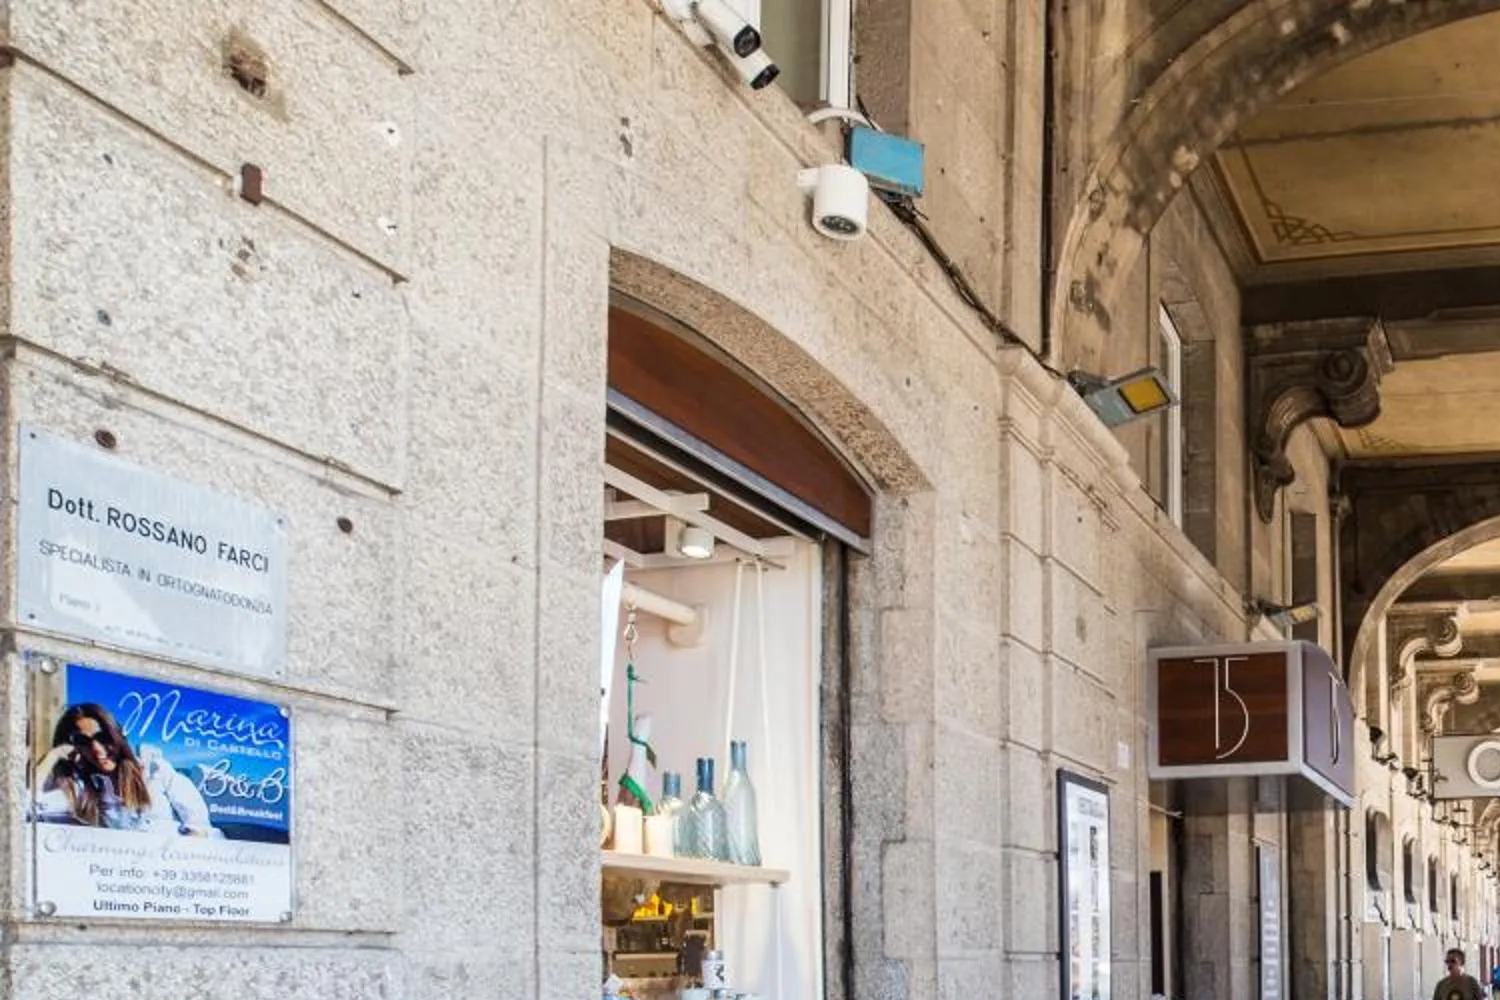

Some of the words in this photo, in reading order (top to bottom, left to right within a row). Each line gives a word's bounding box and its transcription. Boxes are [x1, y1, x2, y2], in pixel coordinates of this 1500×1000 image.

[48, 488, 99, 522] Dott.
[107, 507, 207, 555] ROSSANO
[218, 542, 269, 573] FARCI
[39, 540, 131, 577] SPECIALISTA
[138, 568, 151, 582] IN
[118, 689, 285, 745] Marina
[89, 864, 113, 876] Per
[93, 900, 139, 912] Ultimo
[143, 902, 181, 914] Piano
[194, 903, 216, 916] Top
[219, 905, 250, 917] Floor
